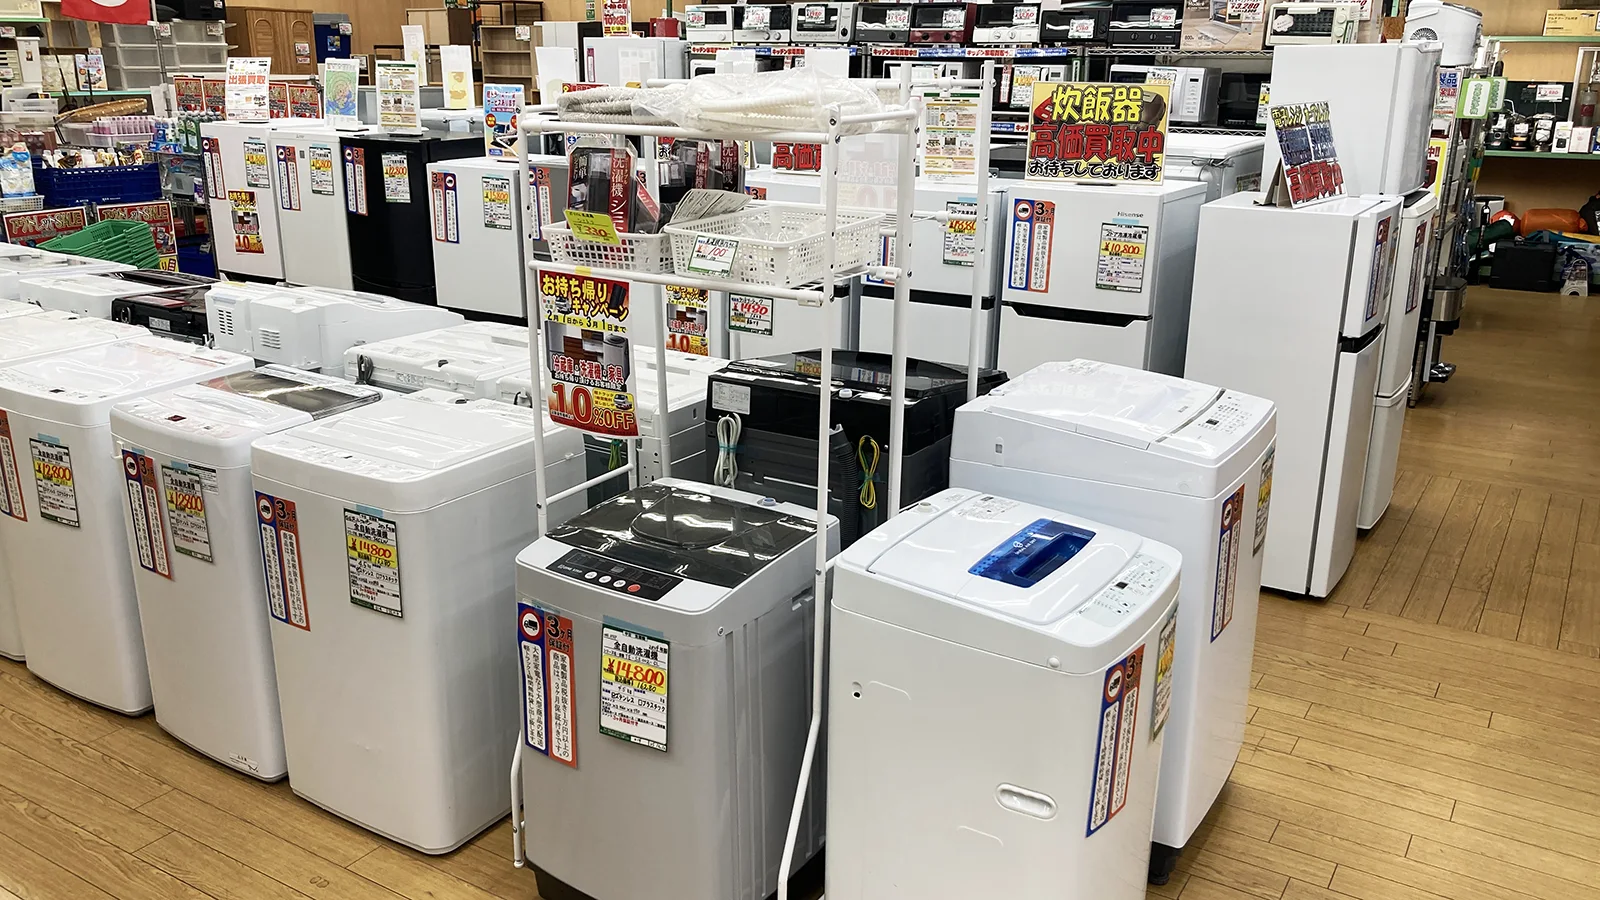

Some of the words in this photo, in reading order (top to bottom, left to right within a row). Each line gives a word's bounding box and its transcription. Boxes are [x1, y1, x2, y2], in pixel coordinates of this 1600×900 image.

[228, 74, 266, 85] 出張買取
[1051, 84, 1143, 122] 炊飯器
[1030, 121, 1165, 164] 高価買取中
[1028, 160, 1162, 180] お待ちしております
[541, 273, 608, 303] お持ち帰り
[572, 297, 630, 322] キャンペーン
[668, 333, 691, 353] 10
[547, 614, 573, 642] 3ヶ月
[613, 641, 659, 661] 全自動洗濯機
